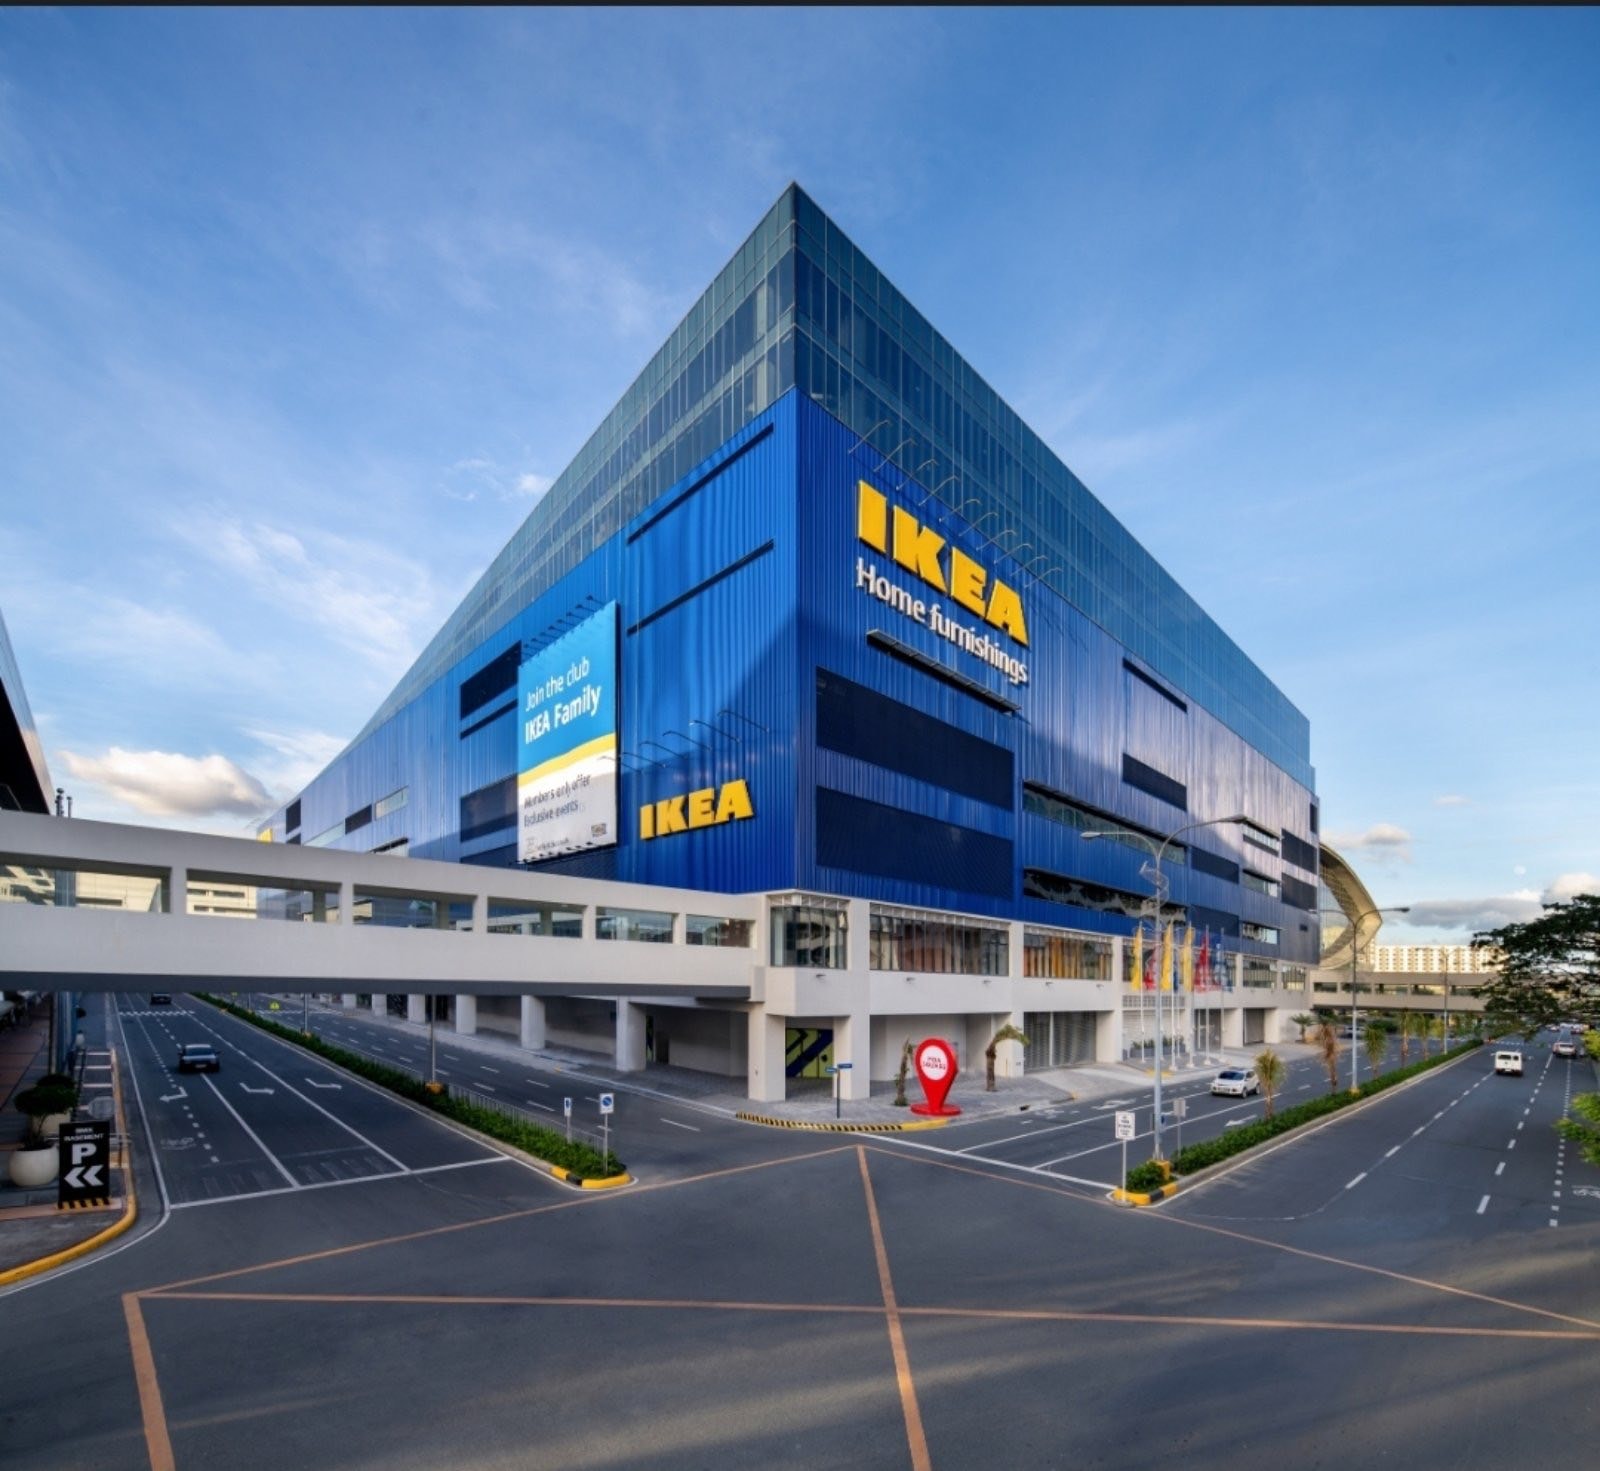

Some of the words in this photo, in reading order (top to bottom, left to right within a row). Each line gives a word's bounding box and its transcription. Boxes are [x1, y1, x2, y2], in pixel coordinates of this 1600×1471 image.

[858, 479, 1029, 646] IKEA
[856, 557, 926, 623] Home
[929, 604, 1029, 685] furnishings
[525, 686, 545, 712] Join
[546, 675, 564, 698] the
[567, 656, 590, 687] club
[525, 709, 551, 745] IKEA
[554, 684, 602, 729] Family
[640, 778, 754, 839] IKEA
[72, 1143, 97, 1165] P
